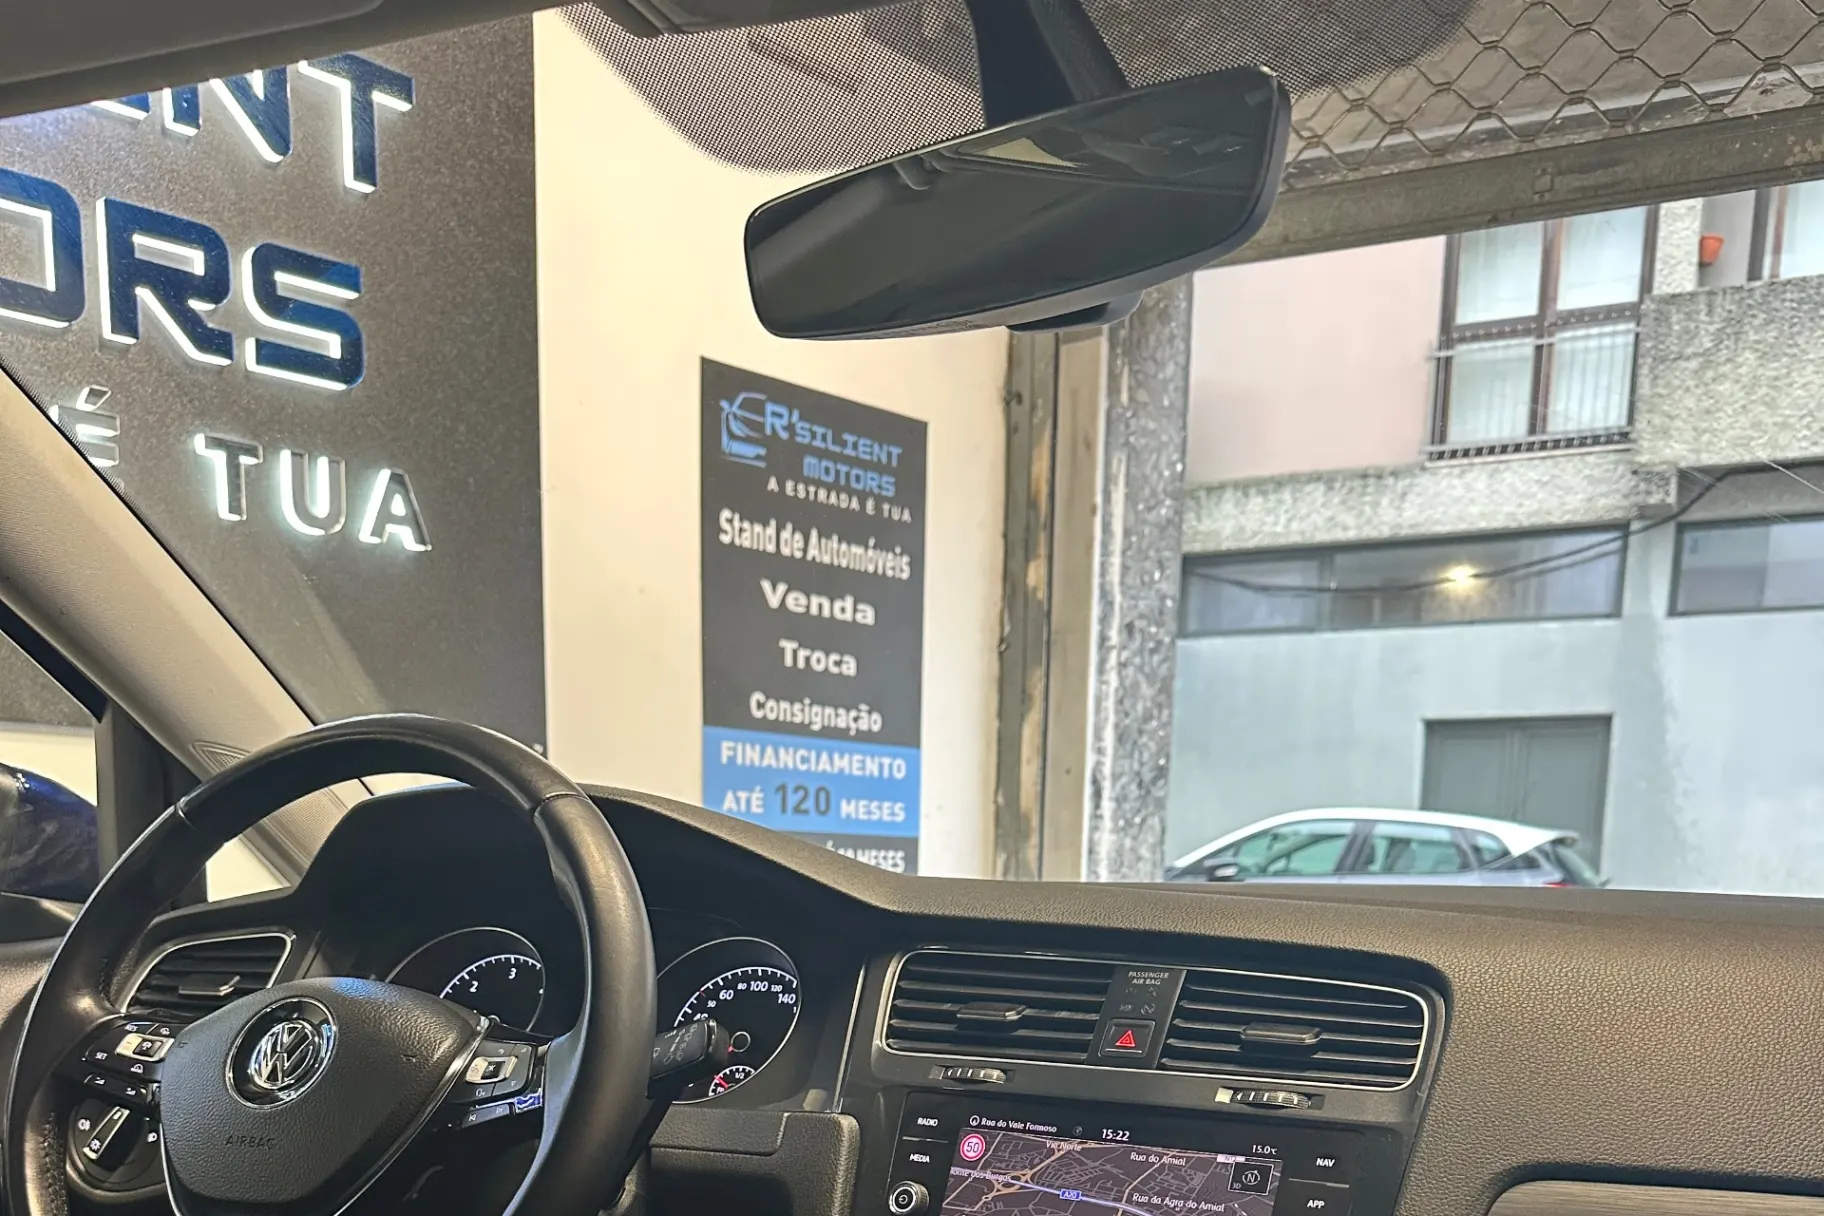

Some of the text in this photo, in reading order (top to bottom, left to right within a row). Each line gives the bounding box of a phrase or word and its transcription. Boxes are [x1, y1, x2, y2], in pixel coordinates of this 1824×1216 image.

[90, 50, 415, 194] NT
[764, 401, 903, 467] R'SILIENT
[803, 454, 896, 497] MOTORS
[194, 432, 432, 551] TUA
[767, 475, 912, 523] A ESTRADA É TUA
[719, 507, 911, 580] Stand de Automóveis
[760, 578, 876, 625] Venda
[778, 638, 858, 677] Troca
[750, 691, 882, 736] Consignação
[720, 740, 906, 780] FINANCIAMENTO
[722, 782, 906, 822] ATÉ 120 MESES
[508, 968, 517, 979] 3
[1128, 971, 1170, 979] PASSENGER
[469, 981, 479, 993] 2
[719, 990, 734, 1000] 60
[750, 981, 768, 991] 100
[770, 984, 783, 992] 120
[777, 993, 796, 1004] 140
[917, 1117, 938, 1127] RADIO
[981, 1117, 1058, 1133] Rua do Vale Formoso
[225, 1134, 275, 1150] AIRBAG
[1101, 1128, 1130, 1141] 15:22
[965, 1142, 980, 1153] 50
[1046, 1140, 1083, 1151] Via Norte
[909, 1153, 930, 1163] MEDIA
[1130, 1151, 1186, 1167] Rua do Amial
[1316, 1157, 1335, 1168] NAV
[1247, 1173, 1256, 1183] N
[1063, 1191, 1077, 1199] A20
[1132, 1193, 1225, 1212] Rua da Agra do Amial
[1307, 1199, 1325, 1209] APP
